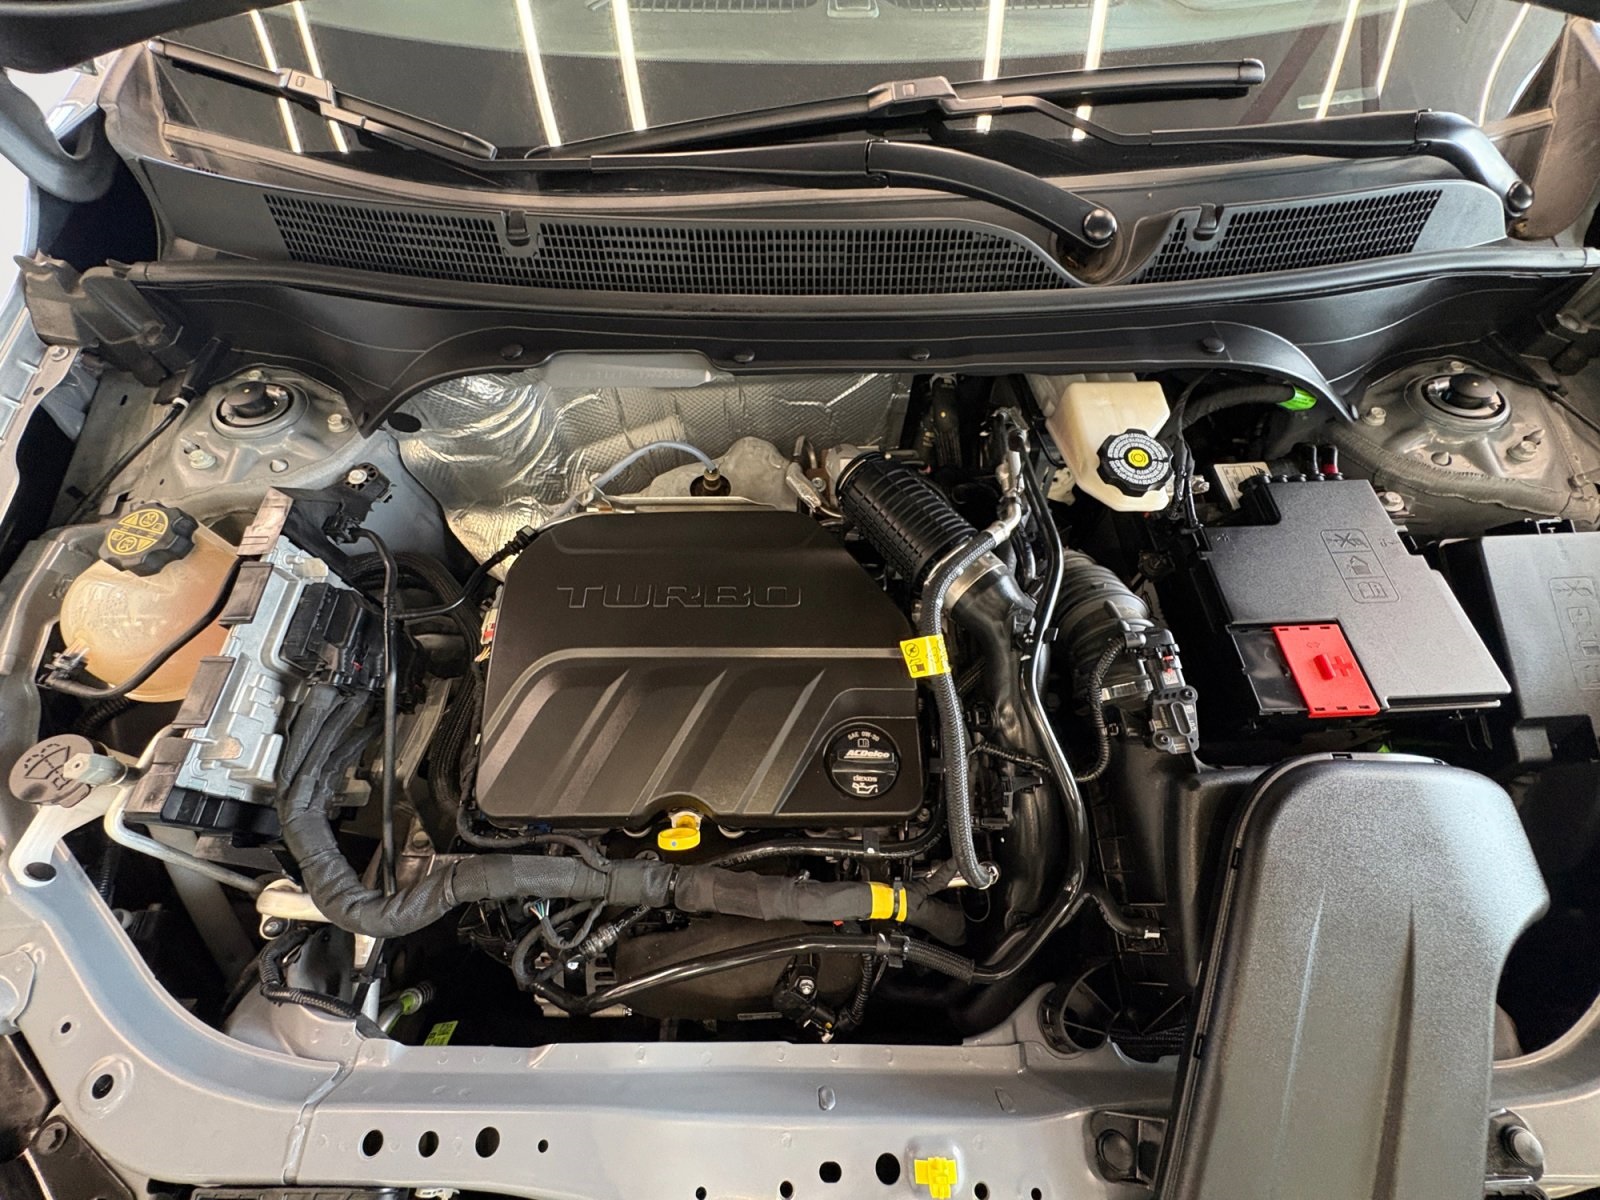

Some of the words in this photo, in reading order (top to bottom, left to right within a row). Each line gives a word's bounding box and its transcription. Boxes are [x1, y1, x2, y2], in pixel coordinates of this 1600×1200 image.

[557, 584, 801, 608] TURBO
[848, 732, 859, 740] SAE
[844, 749, 890, 758] ACDelco
